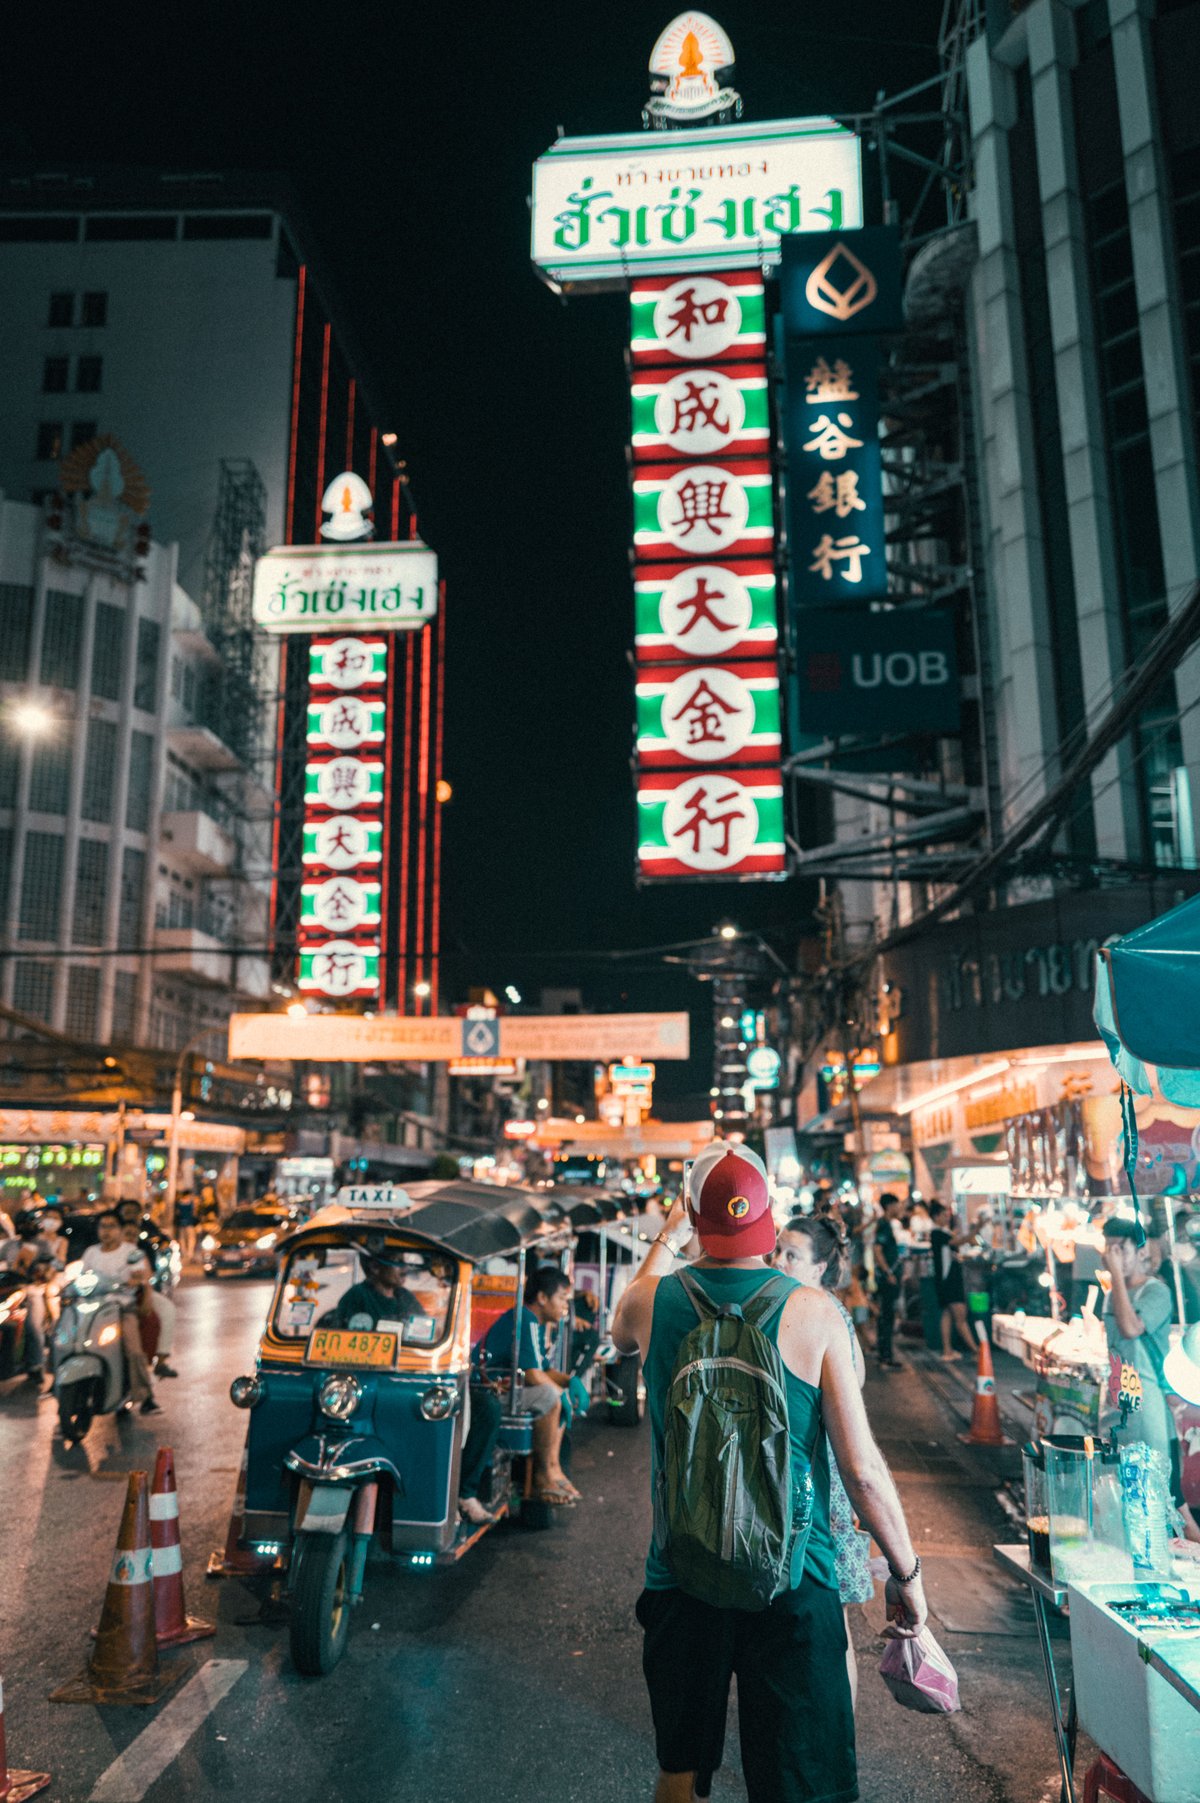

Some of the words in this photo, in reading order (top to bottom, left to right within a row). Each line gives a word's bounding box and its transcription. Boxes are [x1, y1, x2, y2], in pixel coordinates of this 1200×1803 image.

[802, 355, 871, 584] 盤谷銀行
[666, 287, 747, 857] 和成興大金行
[852, 651, 950, 688] UOB
[349, 1189, 393, 1202] TAXI
[348, 1335, 392, 1353] 4879
